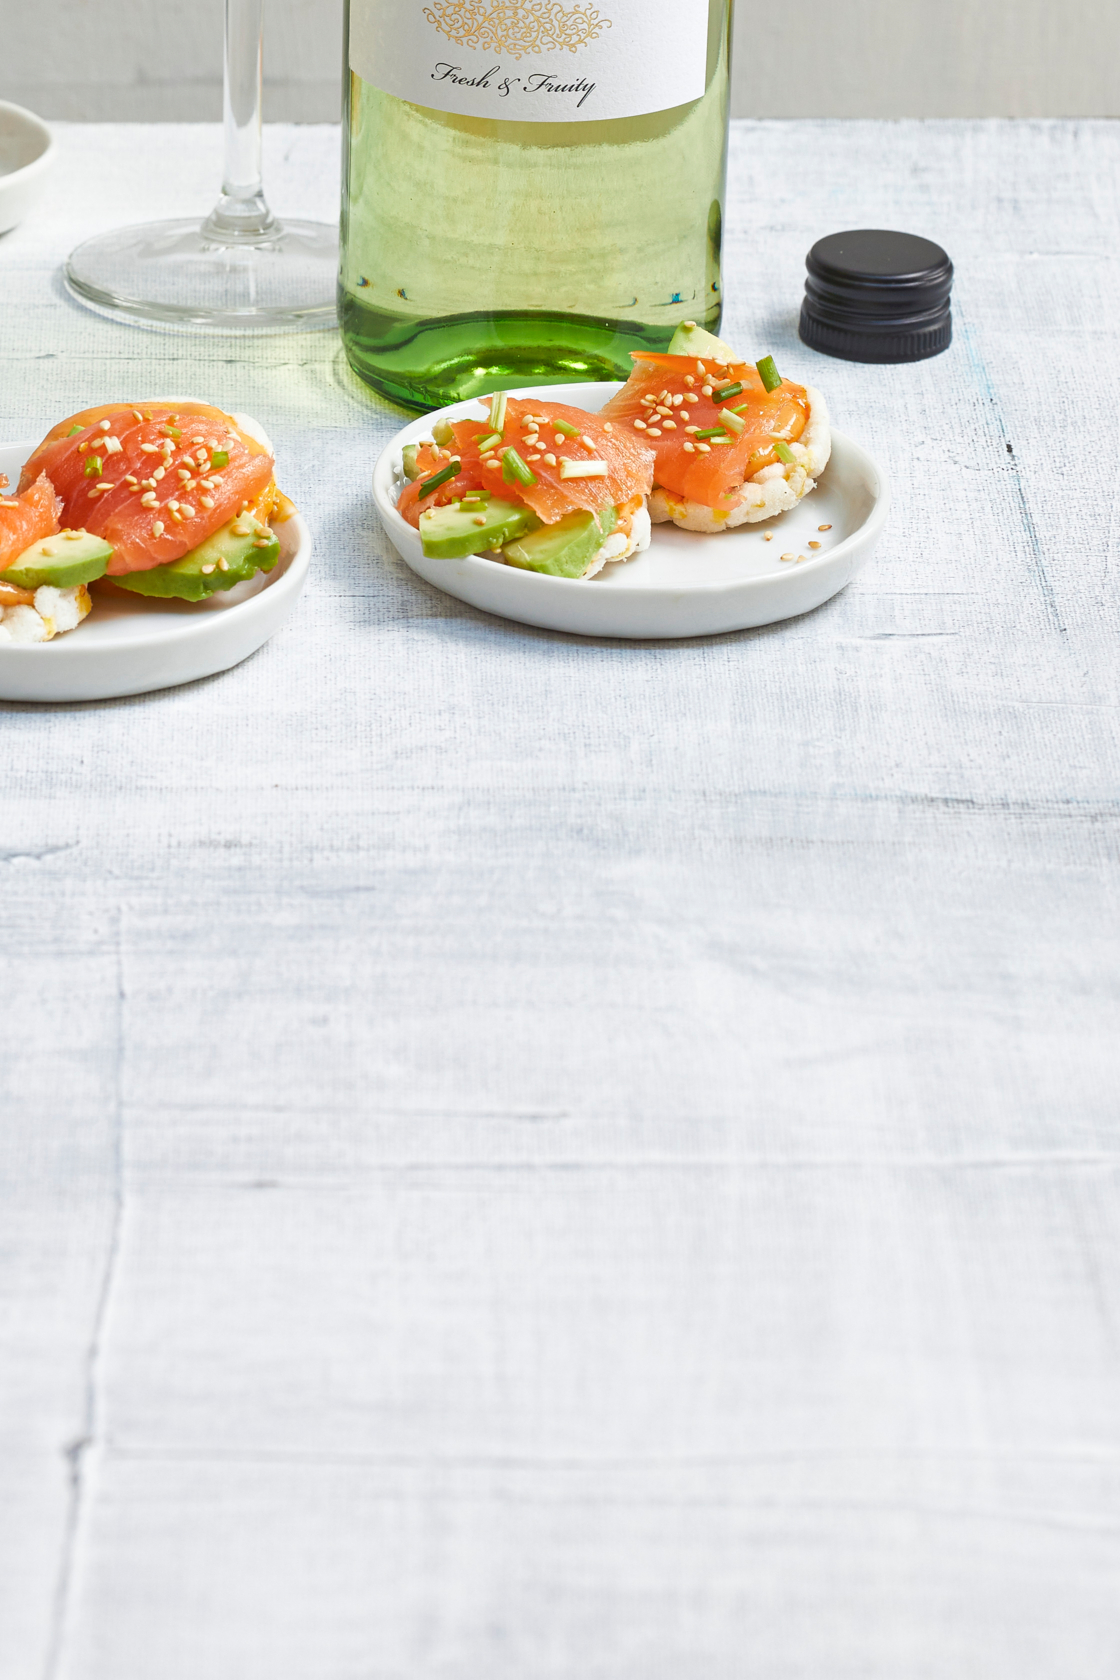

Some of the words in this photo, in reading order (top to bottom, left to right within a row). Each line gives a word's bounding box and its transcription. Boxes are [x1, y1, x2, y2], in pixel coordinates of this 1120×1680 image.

[430, 62, 501, 89] Fresh
[497, 77, 521, 98] &
[523, 73, 597, 108] Fruity
